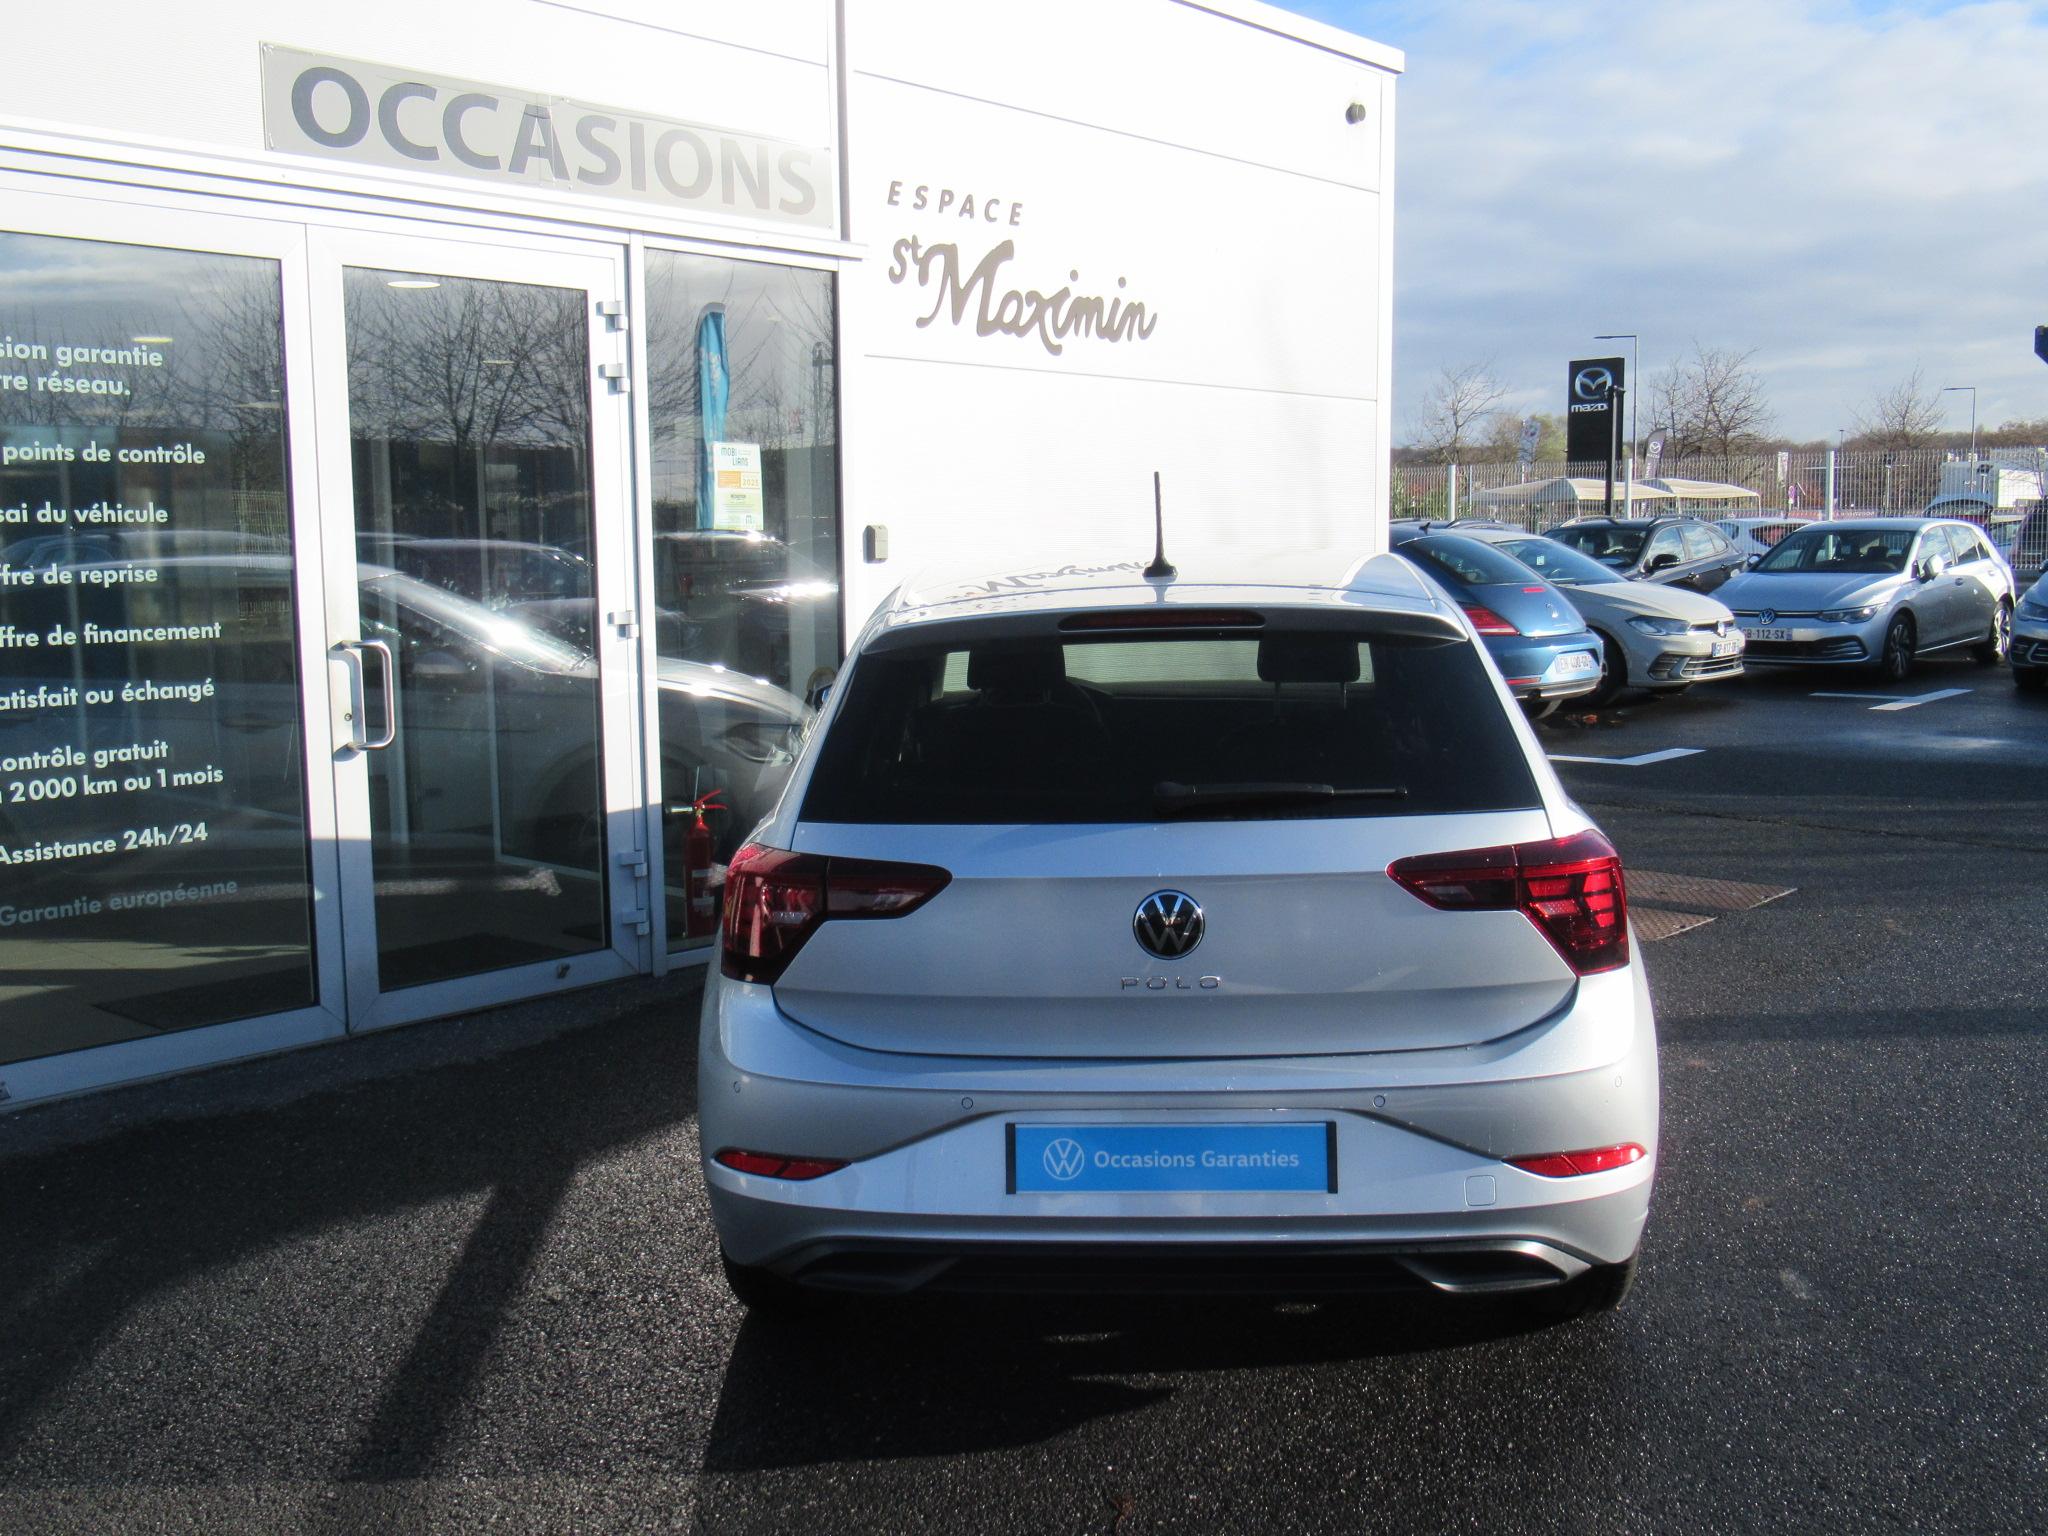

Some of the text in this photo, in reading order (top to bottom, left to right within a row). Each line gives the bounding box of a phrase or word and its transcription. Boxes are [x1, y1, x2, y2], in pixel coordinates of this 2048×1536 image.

[291, 66, 816, 216] OCCASIONS
[887, 181, 1023, 226] ESPACE
[915, 239, 1158, 356] Maximin
[56, 344, 163, 368] garantie
[38, 370, 131, 396] réseau.
[3, 441, 206, 465] points de contrôle
[37, 501, 68, 523] du
[75, 502, 169, 524] véhicule
[43, 563, 73, 586] de
[80, 565, 158, 588] reprise
[47, 624, 77, 646] de
[84, 622, 222, 644] financement
[85, 688, 114, 705] ou
[121, 678, 215, 703] échangé
[0, 740, 168, 772] ontrôle gratuit
[83, 775, 118, 796] km
[124, 774, 151, 791] ou
[156, 768, 167, 788] 1
[173, 765, 223, 787] mois
[0, 822, 208, 865] Assistance 24h/24
[0, 881, 238, 927] Garantie européenne
[1120, 975, 1222, 990] POLO
[1094, 1150, 1196, 1168] Occasions
[1201, 1149, 1300, 1168] Garanties
